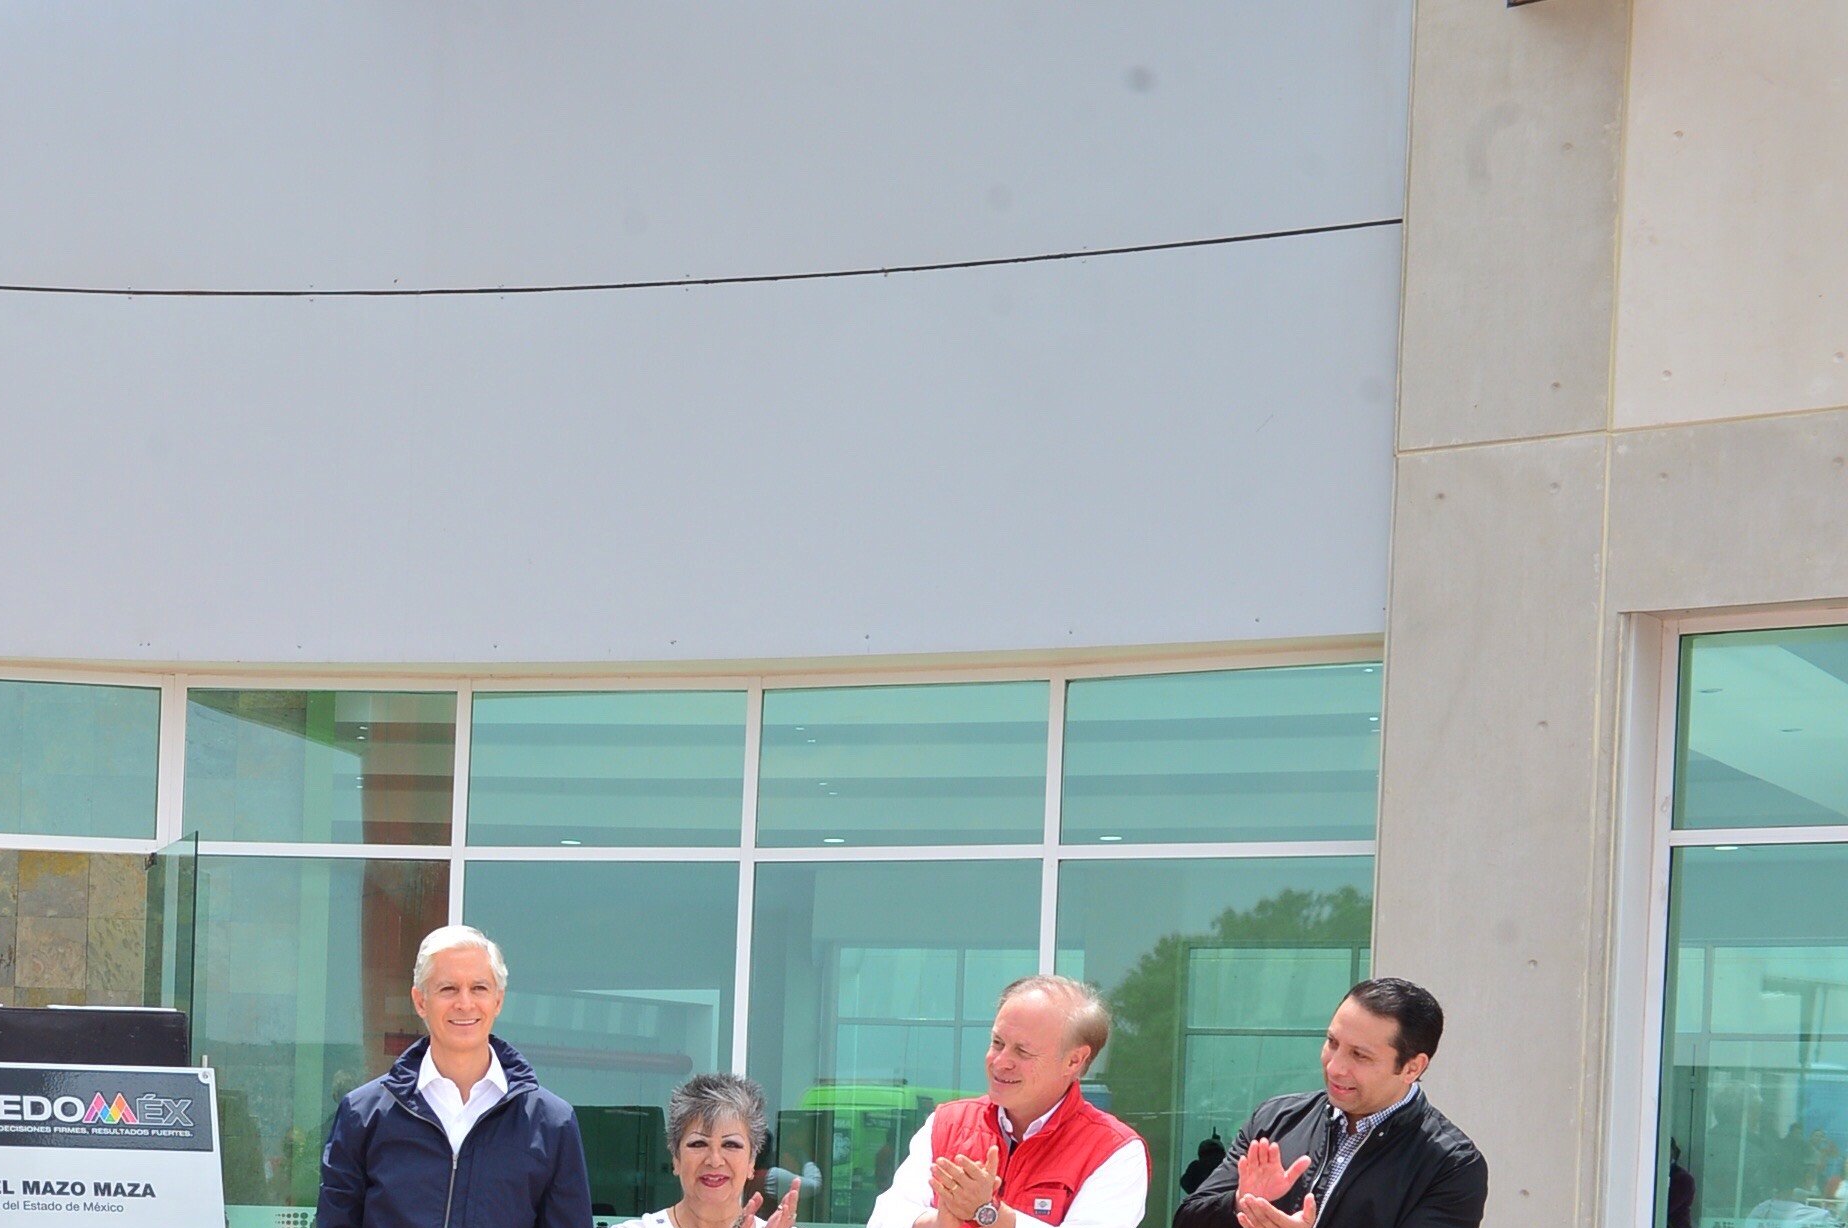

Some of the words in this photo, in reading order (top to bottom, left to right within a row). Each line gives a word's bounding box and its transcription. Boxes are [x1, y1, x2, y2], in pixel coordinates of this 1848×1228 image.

[91, 1128, 149, 1136] RESULTADOS
[152, 1129, 193, 1137] FUERTES.
[22, 1180, 86, 1196] MAZO
[93, 1182, 156, 1198] MAZA
[3, 1201, 19, 1211] del
[23, 1202, 62, 1211] Estado
[65, 1202, 80, 1212] de
[83, 1202, 124, 1213] México
